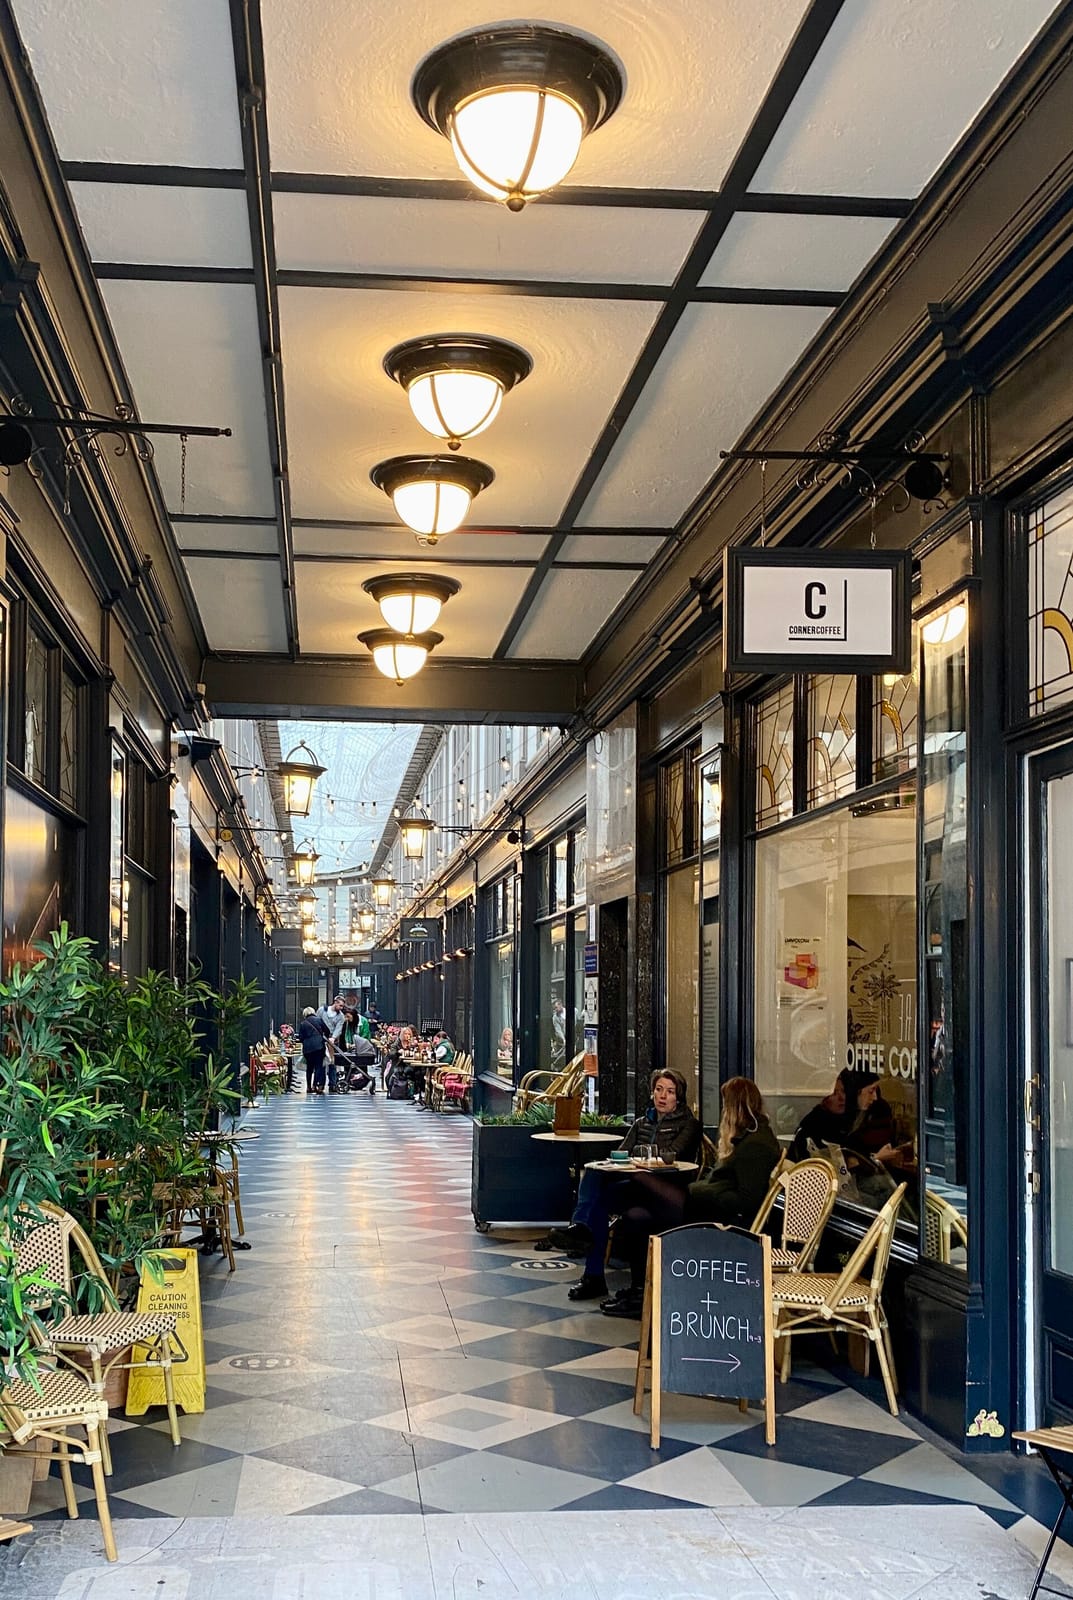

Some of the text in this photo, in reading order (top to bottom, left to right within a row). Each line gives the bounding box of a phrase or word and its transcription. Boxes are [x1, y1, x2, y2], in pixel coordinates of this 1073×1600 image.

[805, 581, 827, 620] C
[789, 625, 841, 635] CORNERCOFFEE
[846, 1042, 885, 1074] OFFEE
[671, 1259, 748, 1285] COFFEE
[147, 1302, 188, 1311] CLEANING
[149, 1293, 187, 1302] CAUTION
[670, 1311, 750, 1343] BRUNCH
